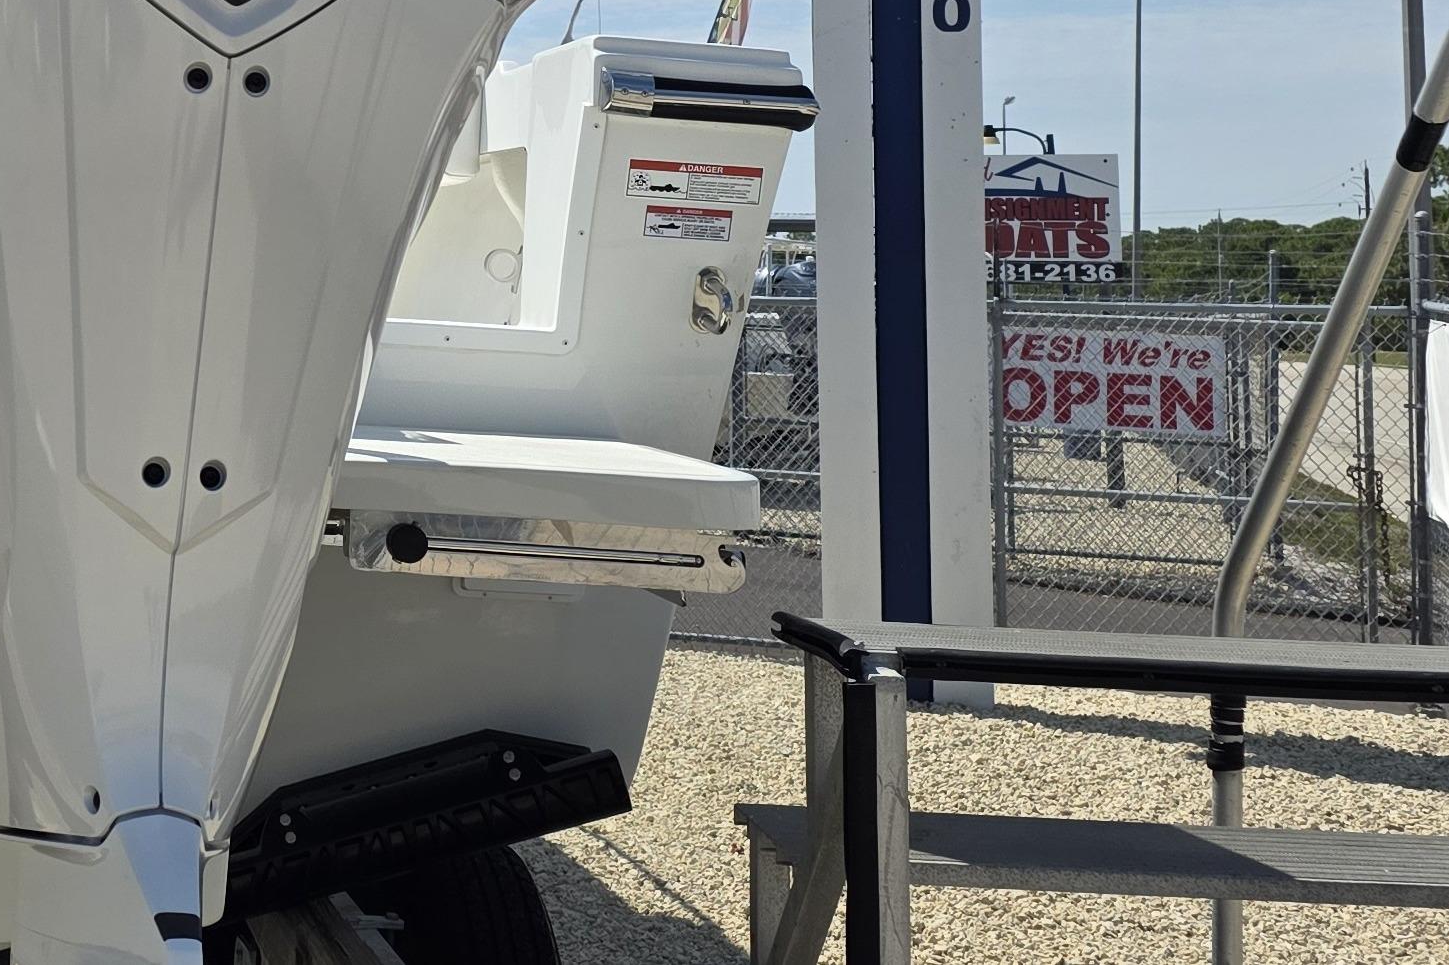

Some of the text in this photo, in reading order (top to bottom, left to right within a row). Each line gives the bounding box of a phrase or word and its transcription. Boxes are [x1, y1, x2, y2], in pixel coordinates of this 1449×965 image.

[687, 164, 724, 174] DANGER
[985, 197, 1110, 221] SIGNMENT
[985, 221, 1111, 259] OATS
[1002, 333, 1212, 370] YES! We're
[1002, 367, 1215, 431] OPEN
